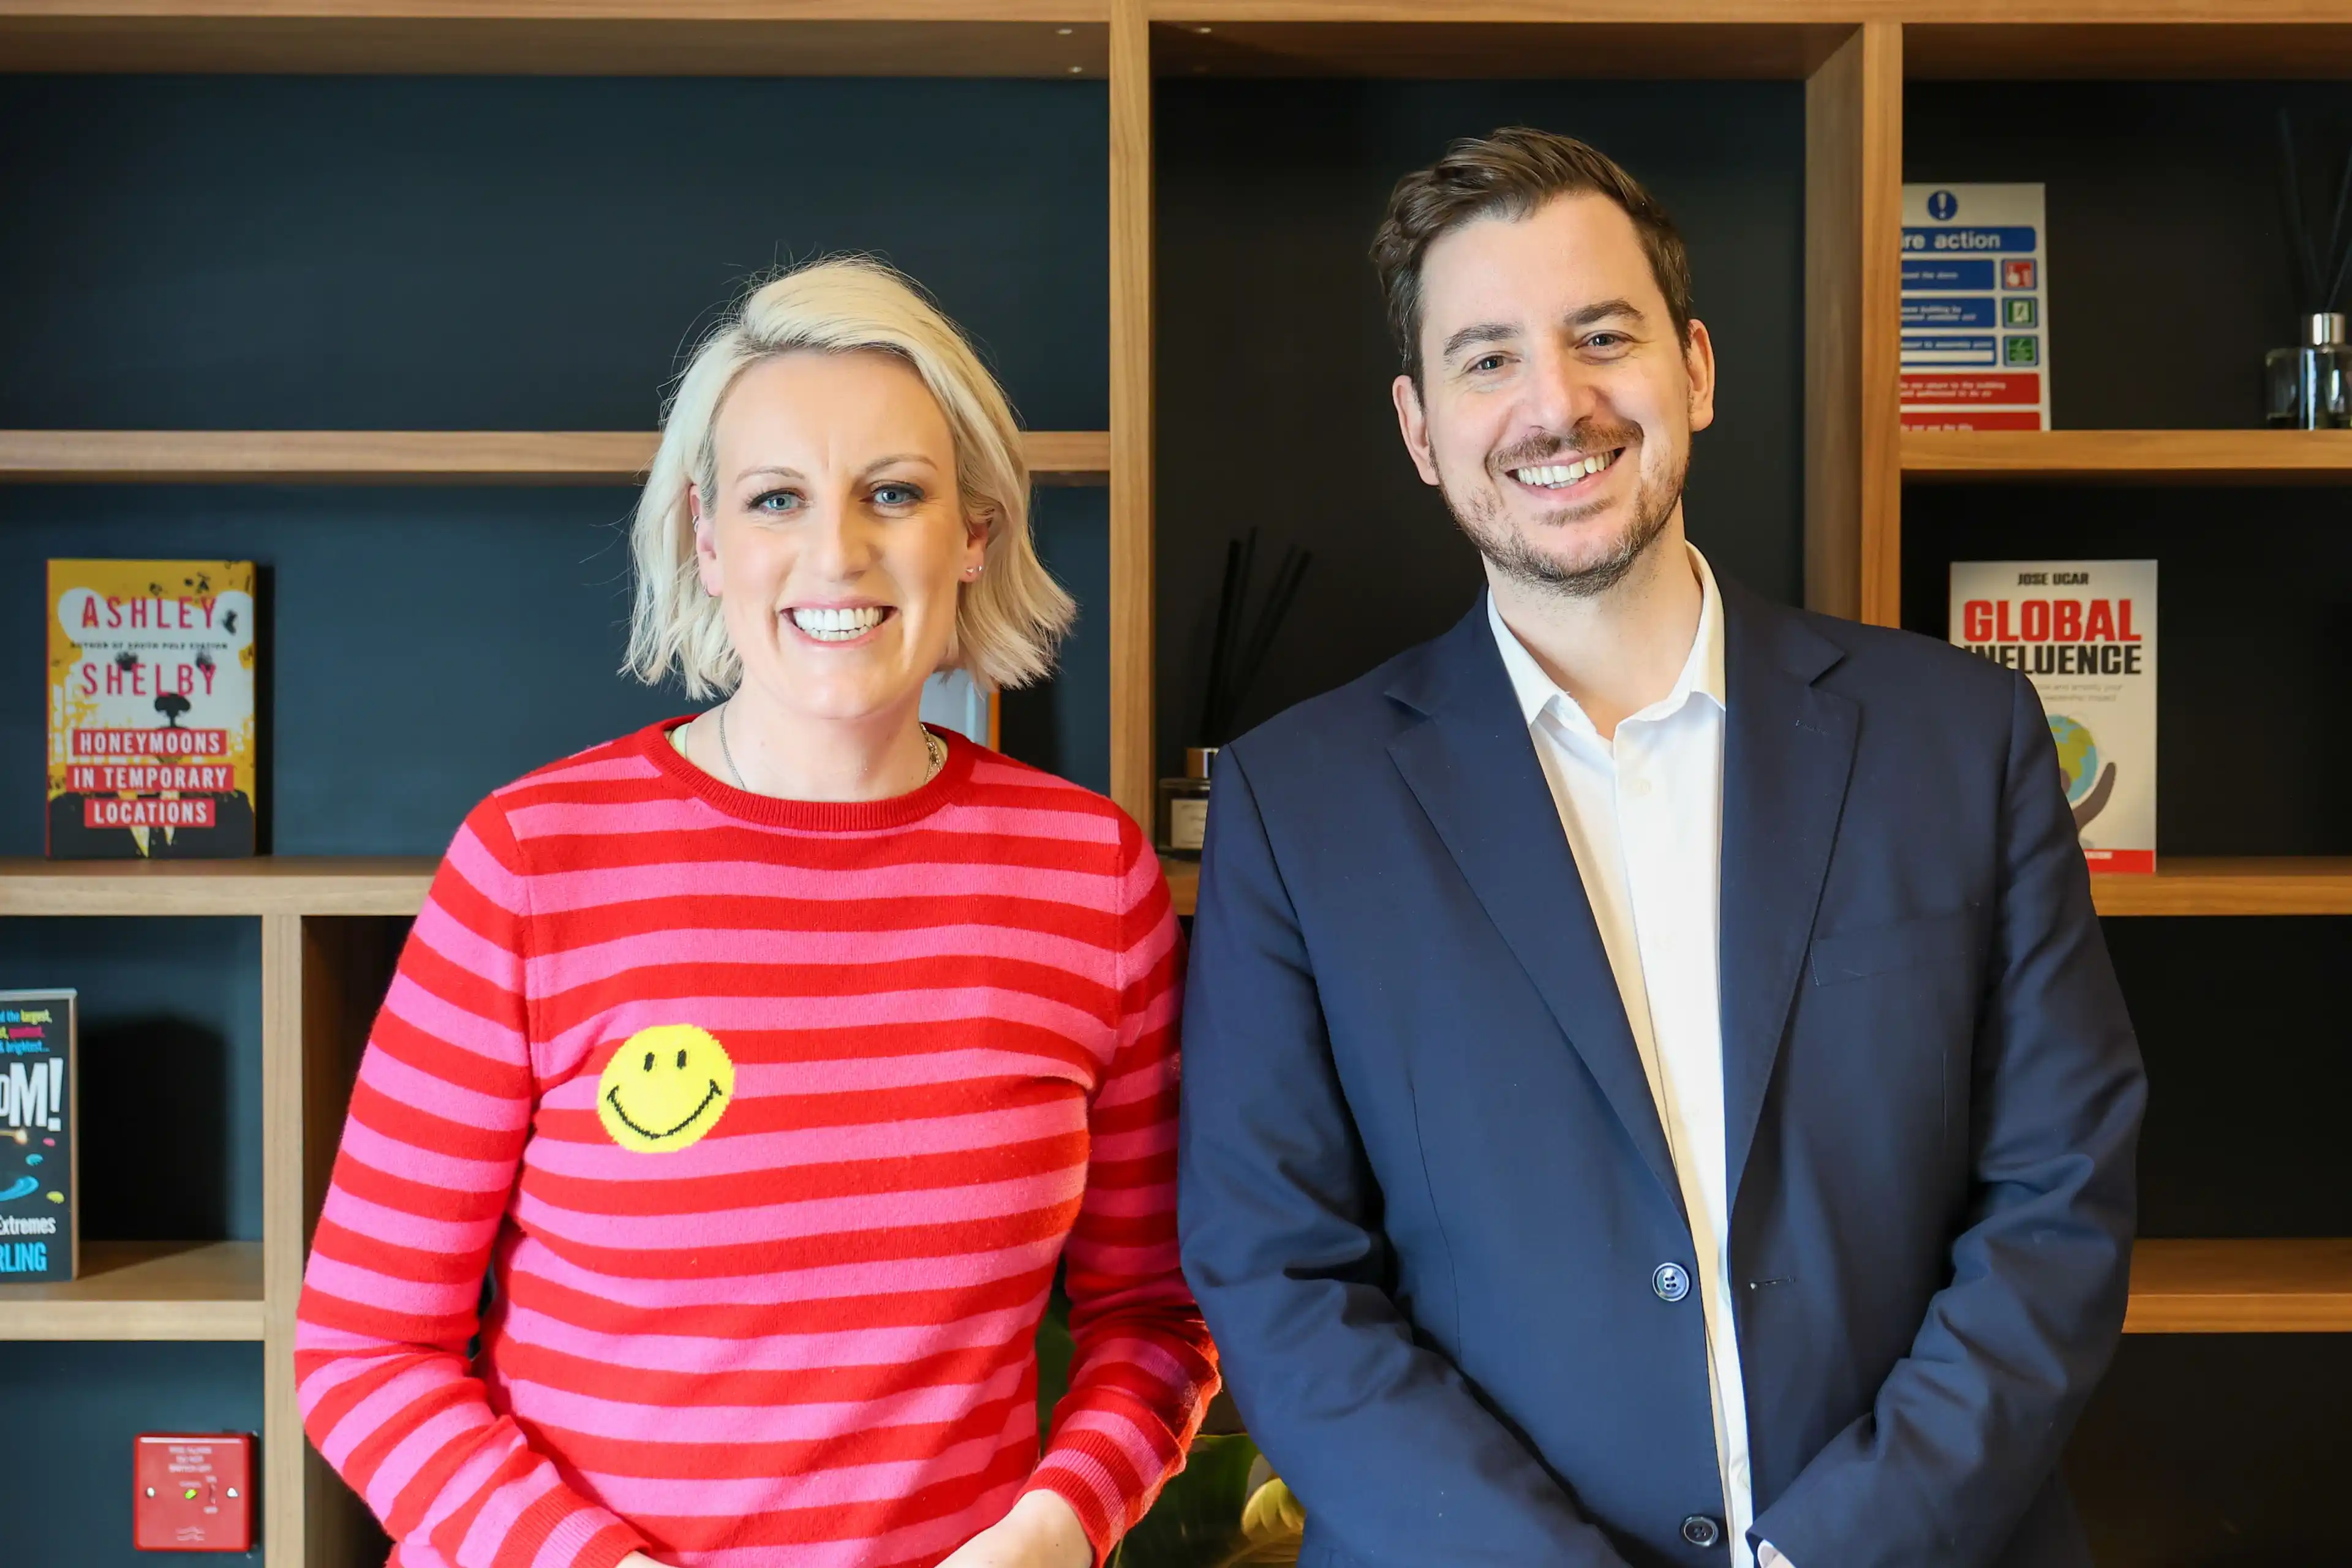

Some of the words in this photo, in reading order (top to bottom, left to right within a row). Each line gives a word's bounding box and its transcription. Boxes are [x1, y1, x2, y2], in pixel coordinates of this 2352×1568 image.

[1934, 230, 2001, 250] action
[2018, 572, 2049, 586] JOSE
[2052, 572, 2089, 586] UCAR
[81, 595, 216, 629] ASHLEY
[1964, 598, 2142, 642] GLOBAL
[1963, 645, 2142, 674] FLUENCE
[81, 662, 216, 697] SHELBY
[80, 731, 221, 754] HONEYMOONS
[74, 767, 95, 789] IN
[103, 766, 228, 789] TEMPORARY
[94, 801, 208, 824] LOCATIONS
